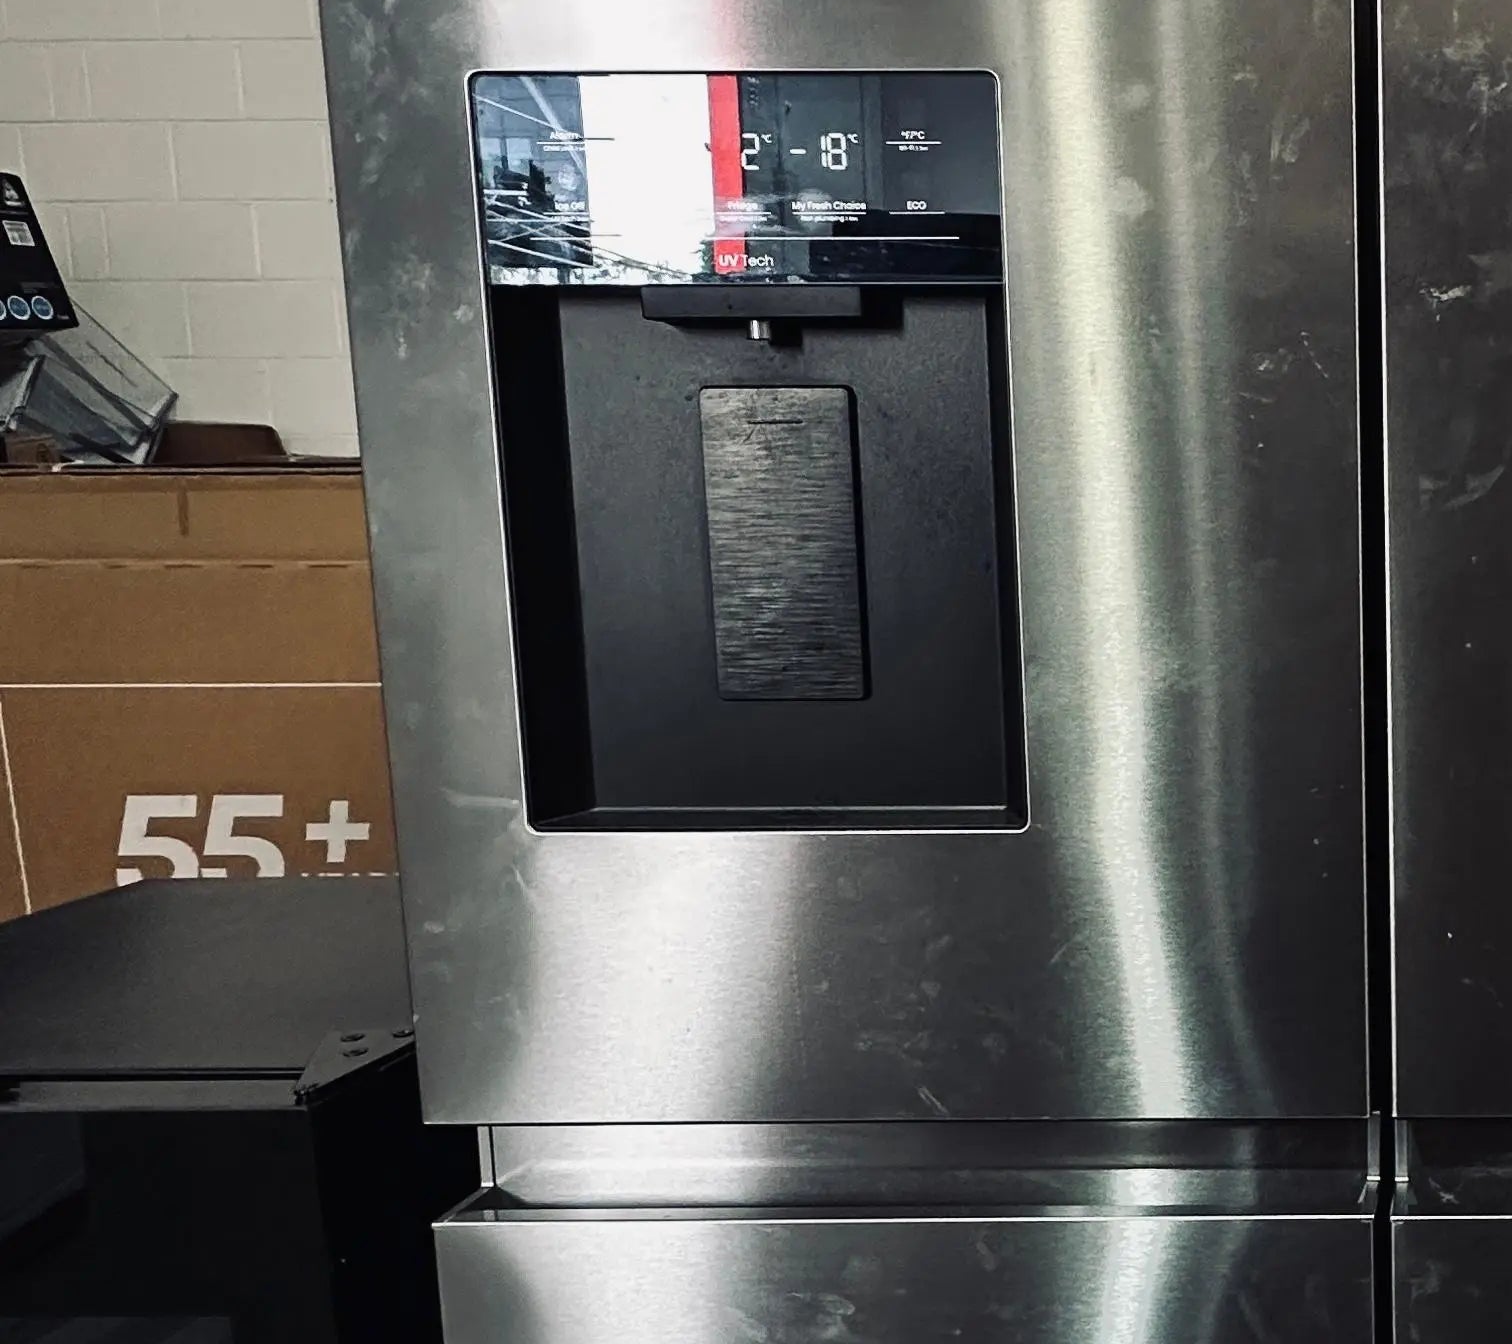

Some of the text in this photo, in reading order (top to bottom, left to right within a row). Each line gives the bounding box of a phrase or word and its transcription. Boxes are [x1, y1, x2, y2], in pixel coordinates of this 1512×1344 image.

[791, 201, 867, 212] My Fresh Choice
[906, 201, 926, 210] ECO
[718, 254, 774, 267] UV Tech
